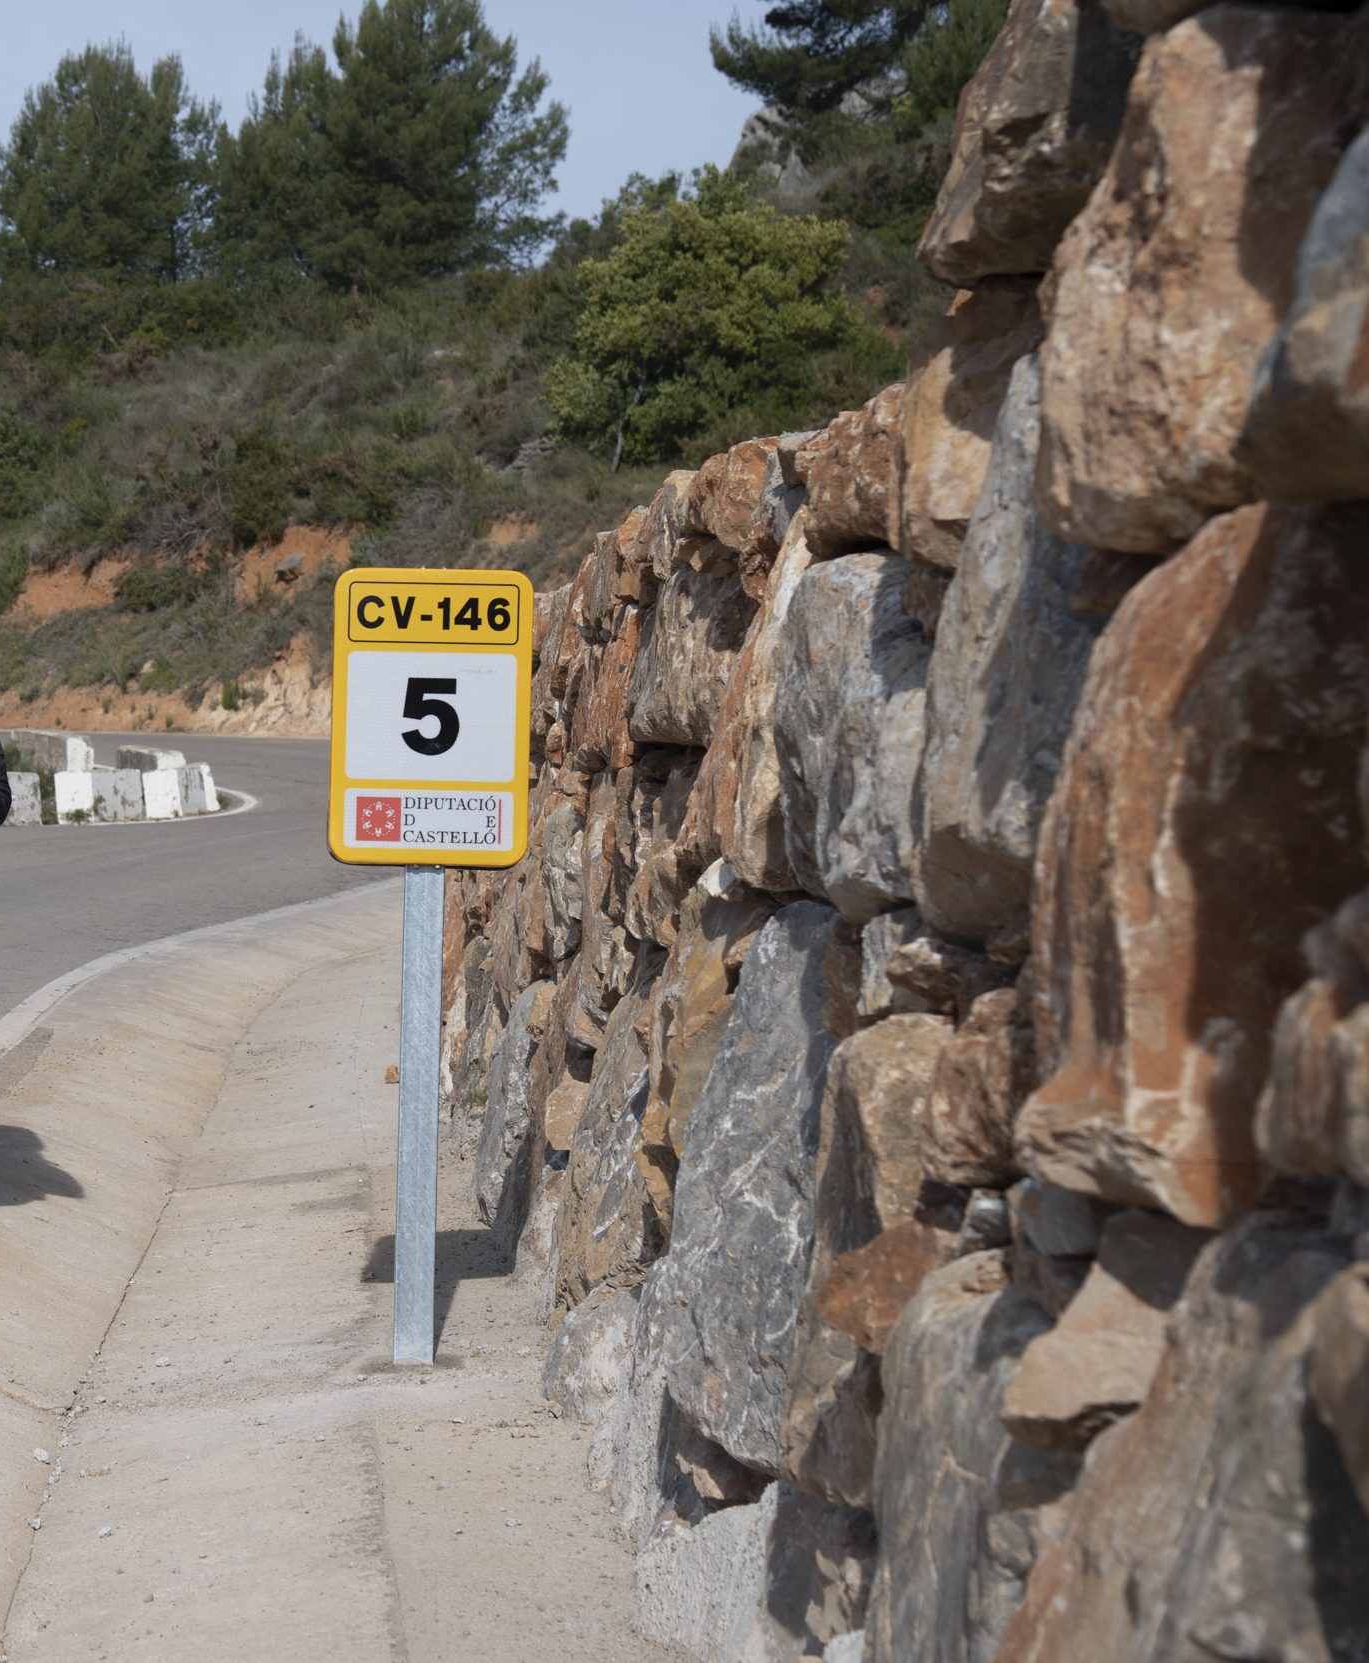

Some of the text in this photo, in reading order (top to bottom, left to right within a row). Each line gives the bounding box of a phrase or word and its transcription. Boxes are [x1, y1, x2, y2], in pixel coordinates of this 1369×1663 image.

[356, 595, 511, 632] CV-146
[401, 677, 460, 756] 5
[403, 795, 497, 812] DIPUTACIÓ
[402, 829, 497, 845] CASTELLÓ
